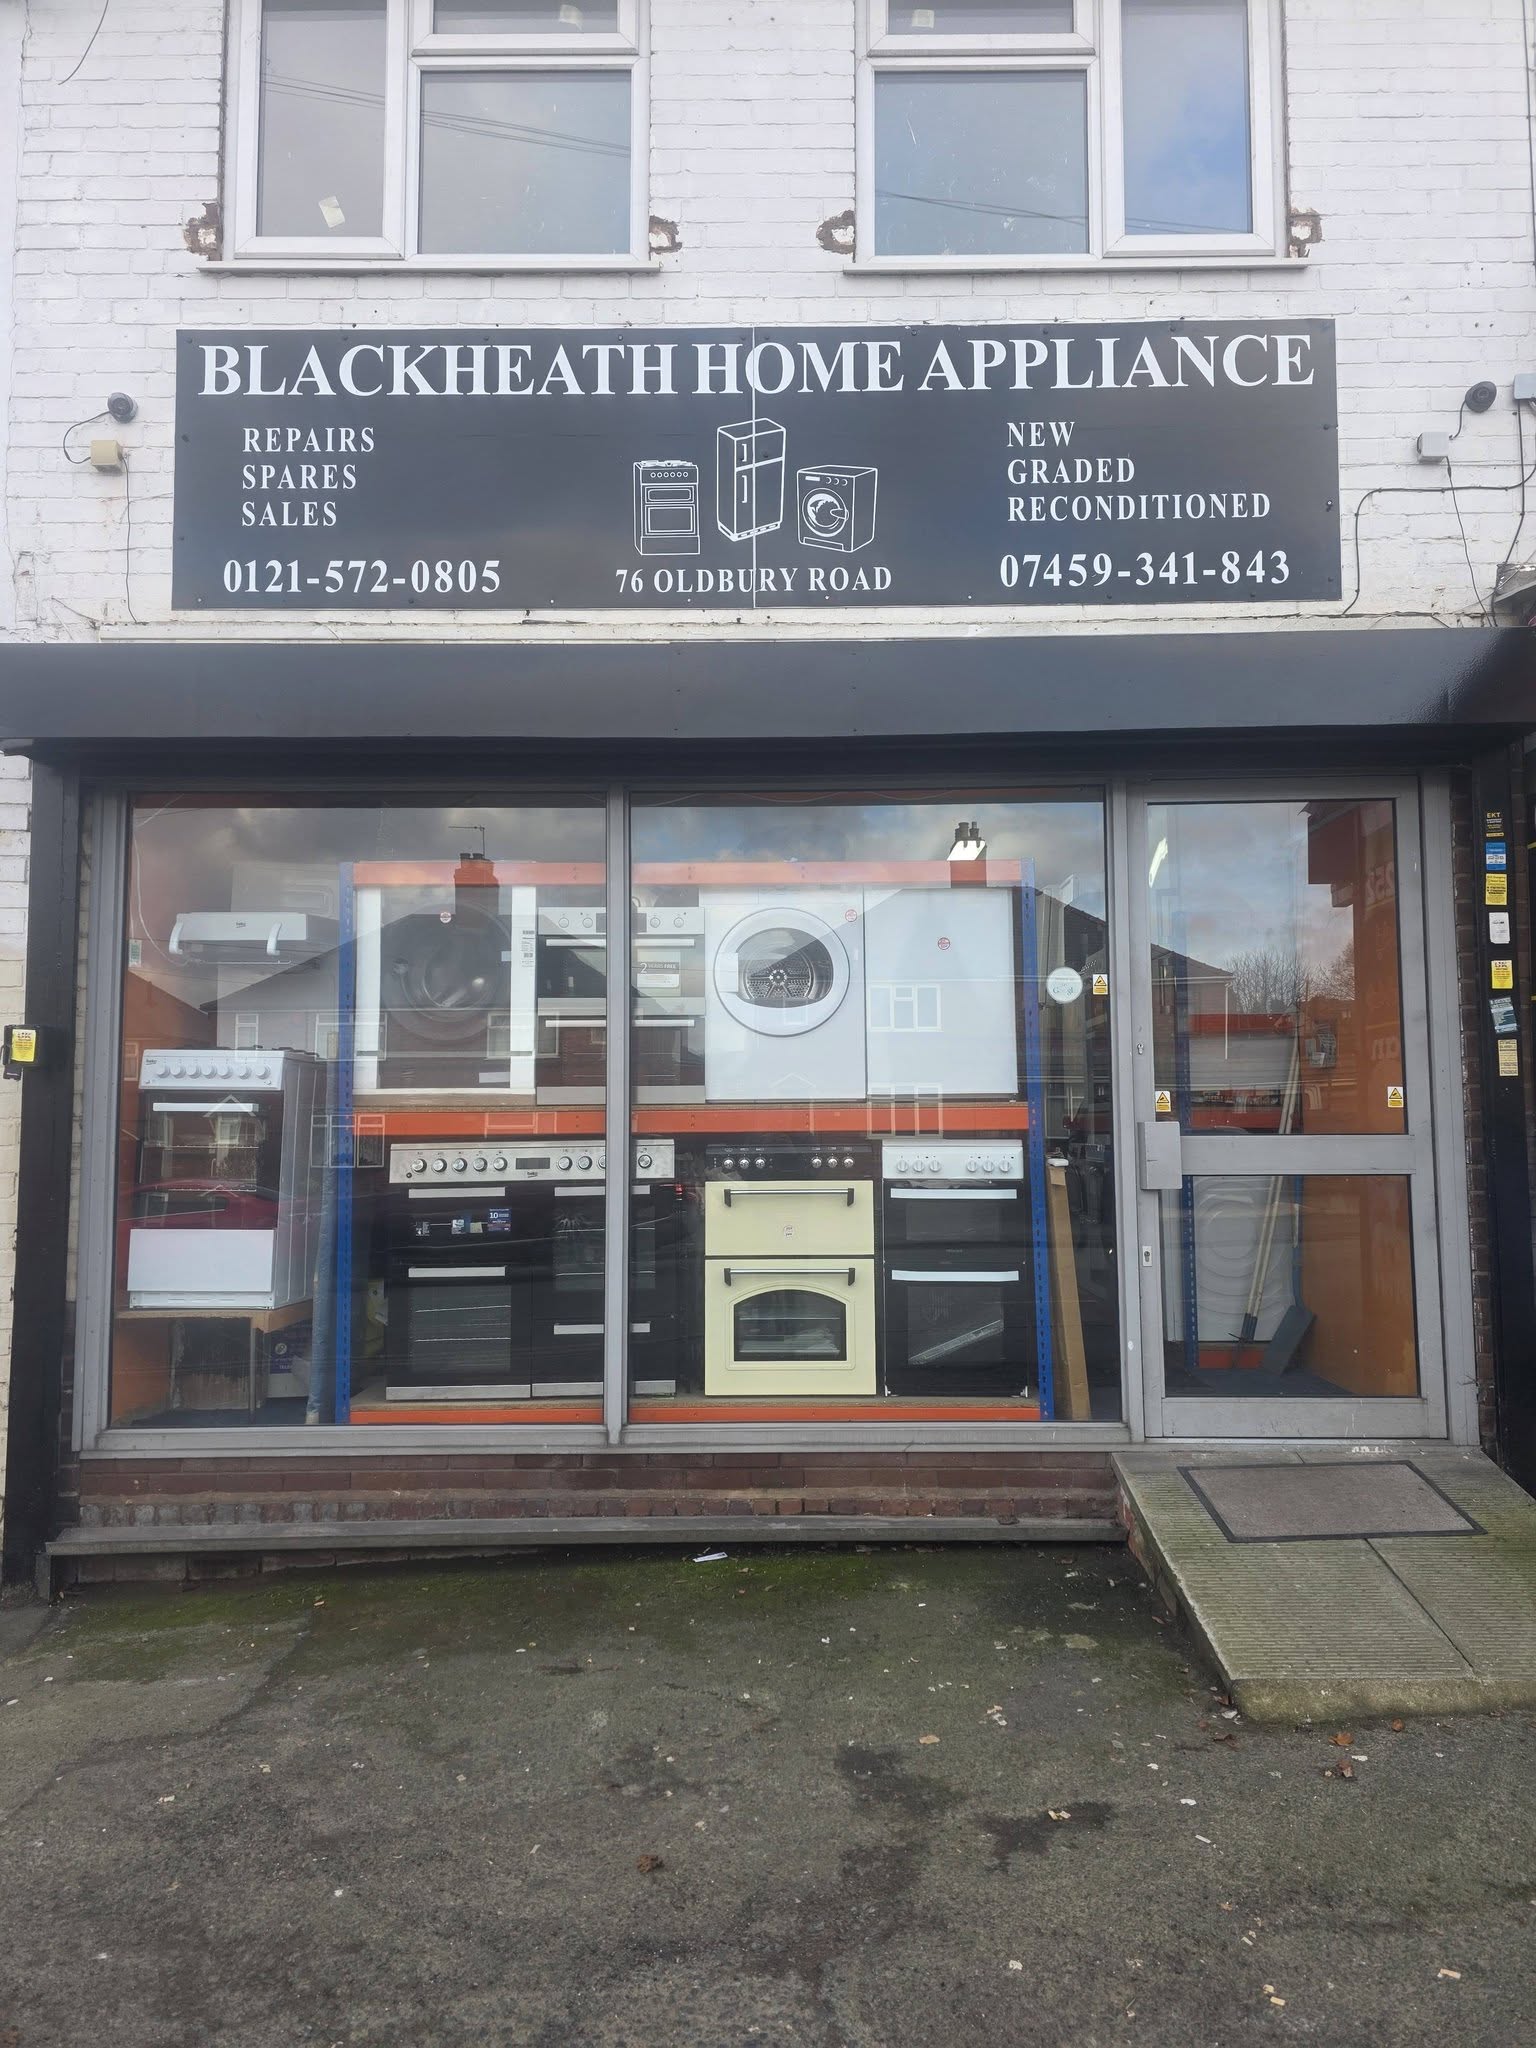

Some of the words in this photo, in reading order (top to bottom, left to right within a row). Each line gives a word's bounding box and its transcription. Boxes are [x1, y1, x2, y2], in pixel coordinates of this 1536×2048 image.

[197, 343, 678, 397] BLACKHEATH
[691, 339, 905, 395] HOME
[916, 333, 1316, 392] APPLIANCE
[242, 426, 375, 454] REPAIRS
[1006, 421, 1077, 448] NEW
[241, 463, 357, 491] SPARES
[1006, 457, 1136, 485] GRADED
[241, 500, 338, 528] SALES
[1007, 492, 1271, 522] RECONDITIONED
[222, 559, 502, 595] 0121-572-0805
[615, 568, 644, 594] 76
[653, 567, 799, 595] OLDBURY
[807, 565, 893, 592] ROAD
[999, 549, 1291, 588] 07459-341-843
[640, 962, 648, 974] 2
